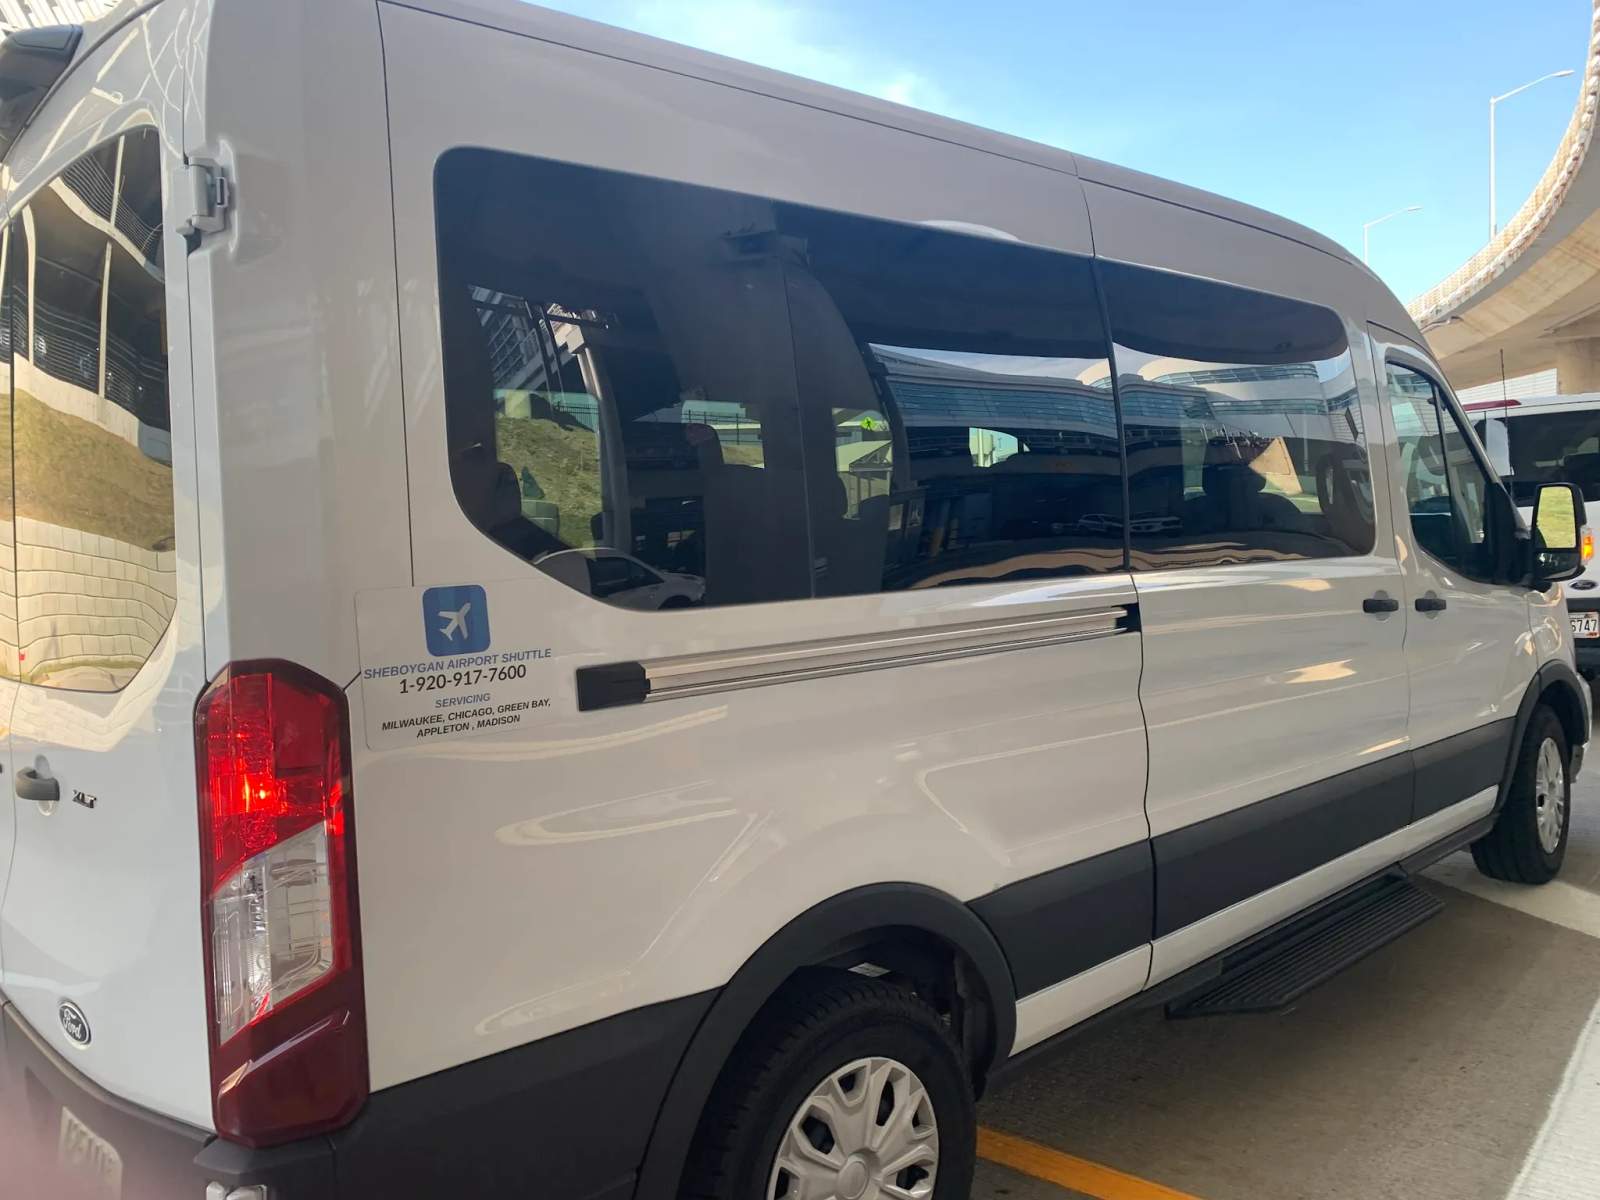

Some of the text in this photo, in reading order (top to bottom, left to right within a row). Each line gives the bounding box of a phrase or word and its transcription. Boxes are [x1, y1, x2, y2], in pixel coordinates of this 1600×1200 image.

[363, 648, 552, 679] SHEBOYGAN AIRPORT SHUTTLE
[400, 664, 526, 694] 1-920-917-7600
[381, 698, 551, 731] MILWAUKEE, CHICAGO, GREEN BAY,
[435, 693, 491, 708] SERVICING
[416, 722, 469, 738] APPLETON
[477, 714, 520, 729] MADISON
[72, 790, 97, 808] XLT
[63, 1008, 82, 1040] Ford
